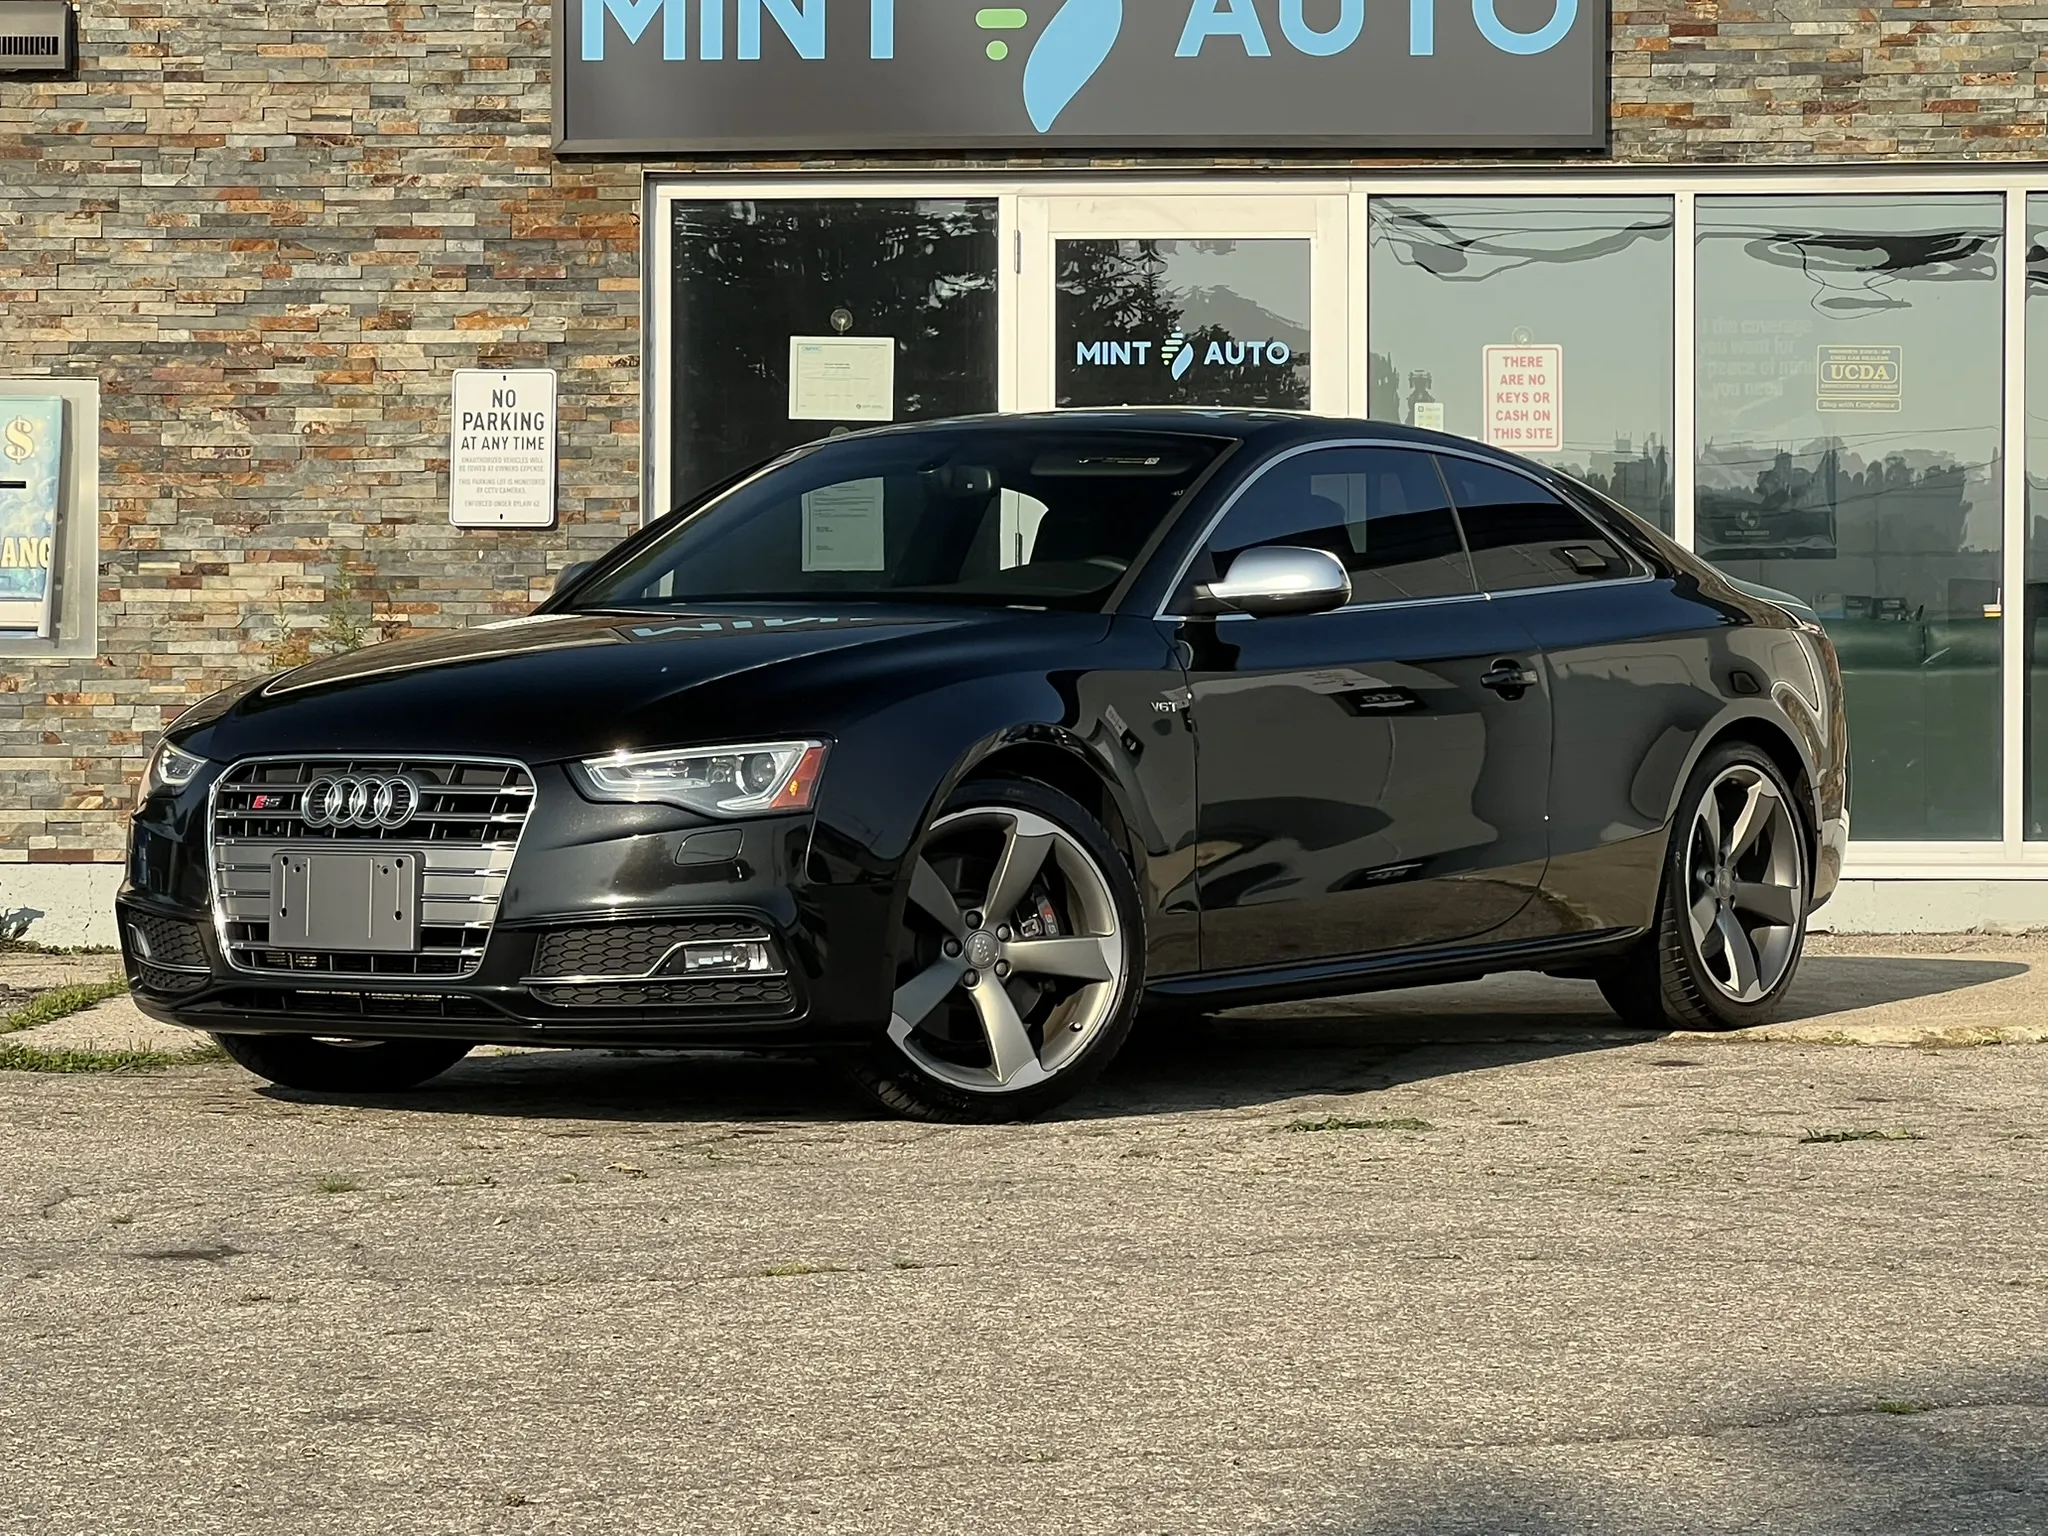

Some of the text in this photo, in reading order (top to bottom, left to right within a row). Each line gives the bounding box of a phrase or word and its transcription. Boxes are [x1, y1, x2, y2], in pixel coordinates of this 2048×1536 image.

[1076, 341, 1290, 365] MINT AUTO
[1502, 356, 1543, 368] THERE
[1830, 364, 1890, 380] UCDA
[1500, 374, 1546, 386] ARE NO
[491, 389, 517, 408] NO
[1496, 392, 1550, 404] KEYS OR
[462, 412, 545, 431] PARKING
[1495, 410, 1551, 422] CASH ON
[4, 415, 35, 464] $
[1493, 428, 1553, 440] THIS SITE
[461, 436, 545, 450] AT ANY TIME
[1151, 701, 1178, 712] V6T
